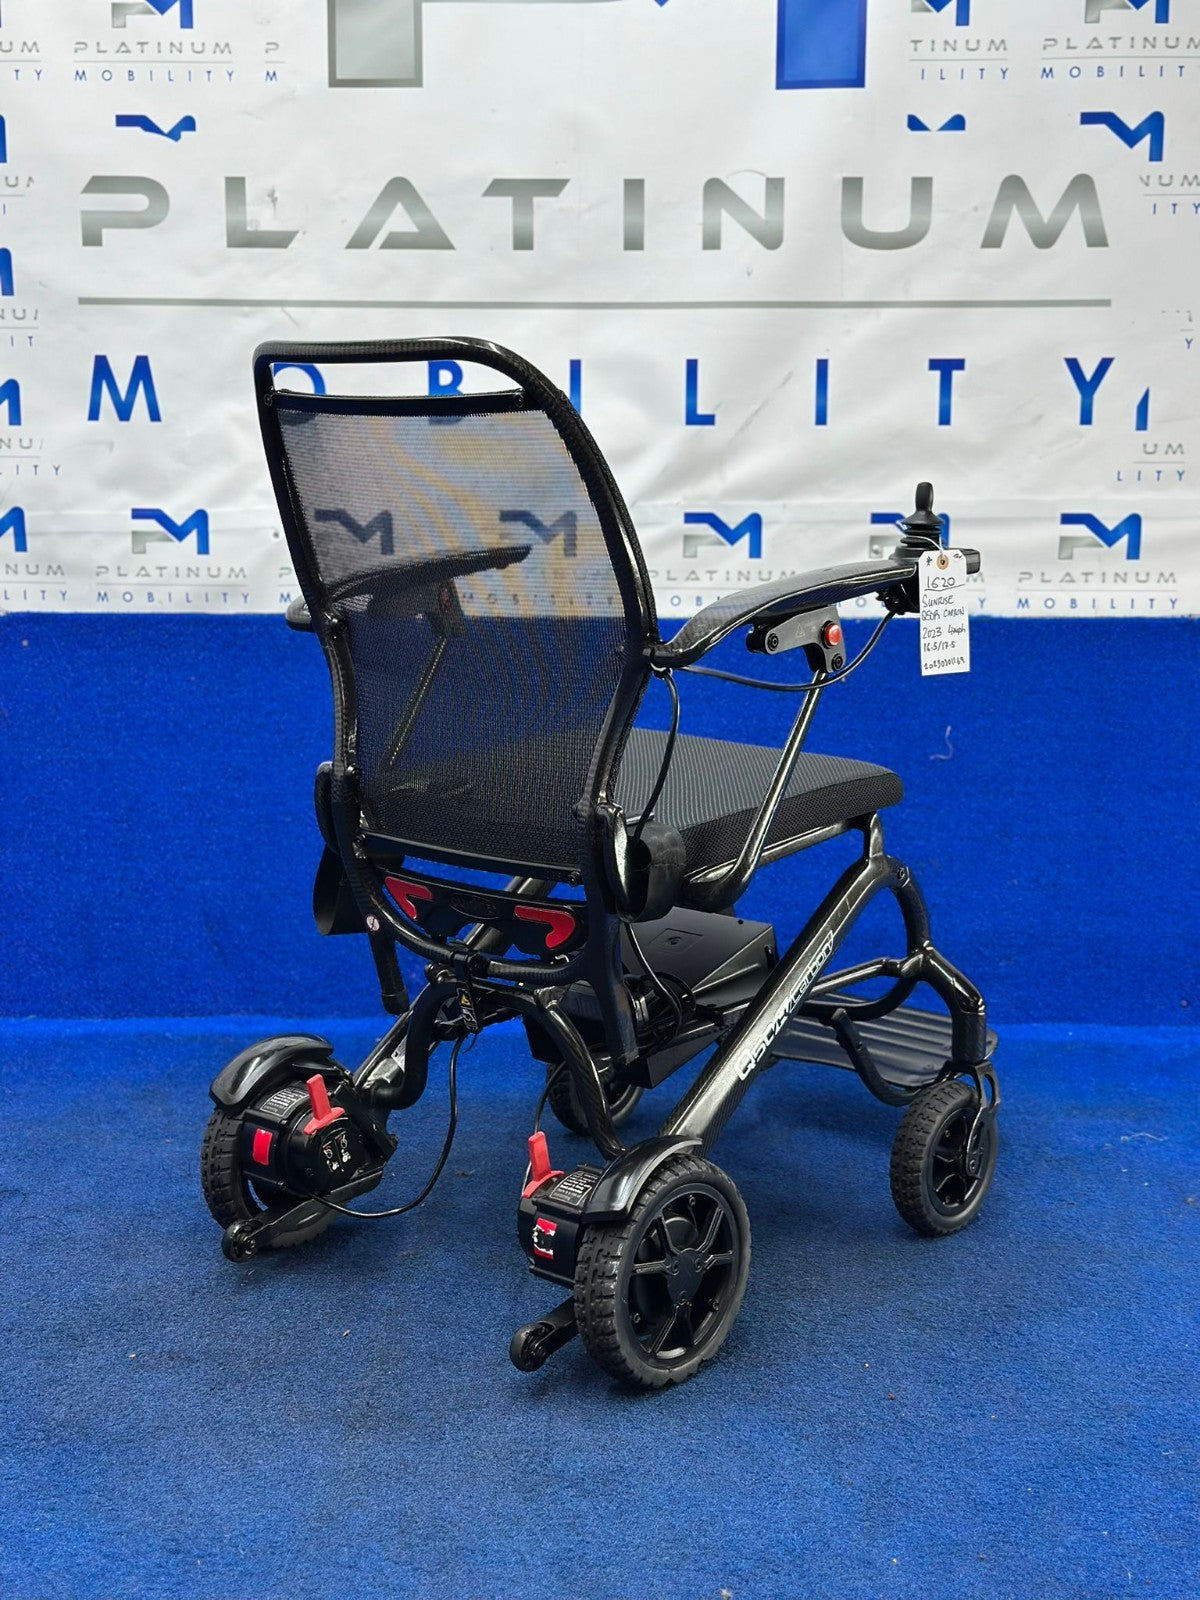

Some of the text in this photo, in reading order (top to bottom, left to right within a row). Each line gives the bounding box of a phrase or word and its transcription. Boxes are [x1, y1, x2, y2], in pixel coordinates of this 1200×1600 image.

[74, 42, 231, 54] PLATINUM
[75, 70, 234, 81] MOBILITY
[81, 173, 1109, 251] PLATINUM
[87, 355, 1115, 425] MOBILITY
[96, 566, 246, 578] PLATINUM
[1019, 572, 1176, 583] PLATINUM
[926, 576, 956, 589] 1620
[97, 592, 249, 603] MOBILITY
[1017, 598, 1178, 609] MOBILITY
[922, 627, 943, 640] 2023
